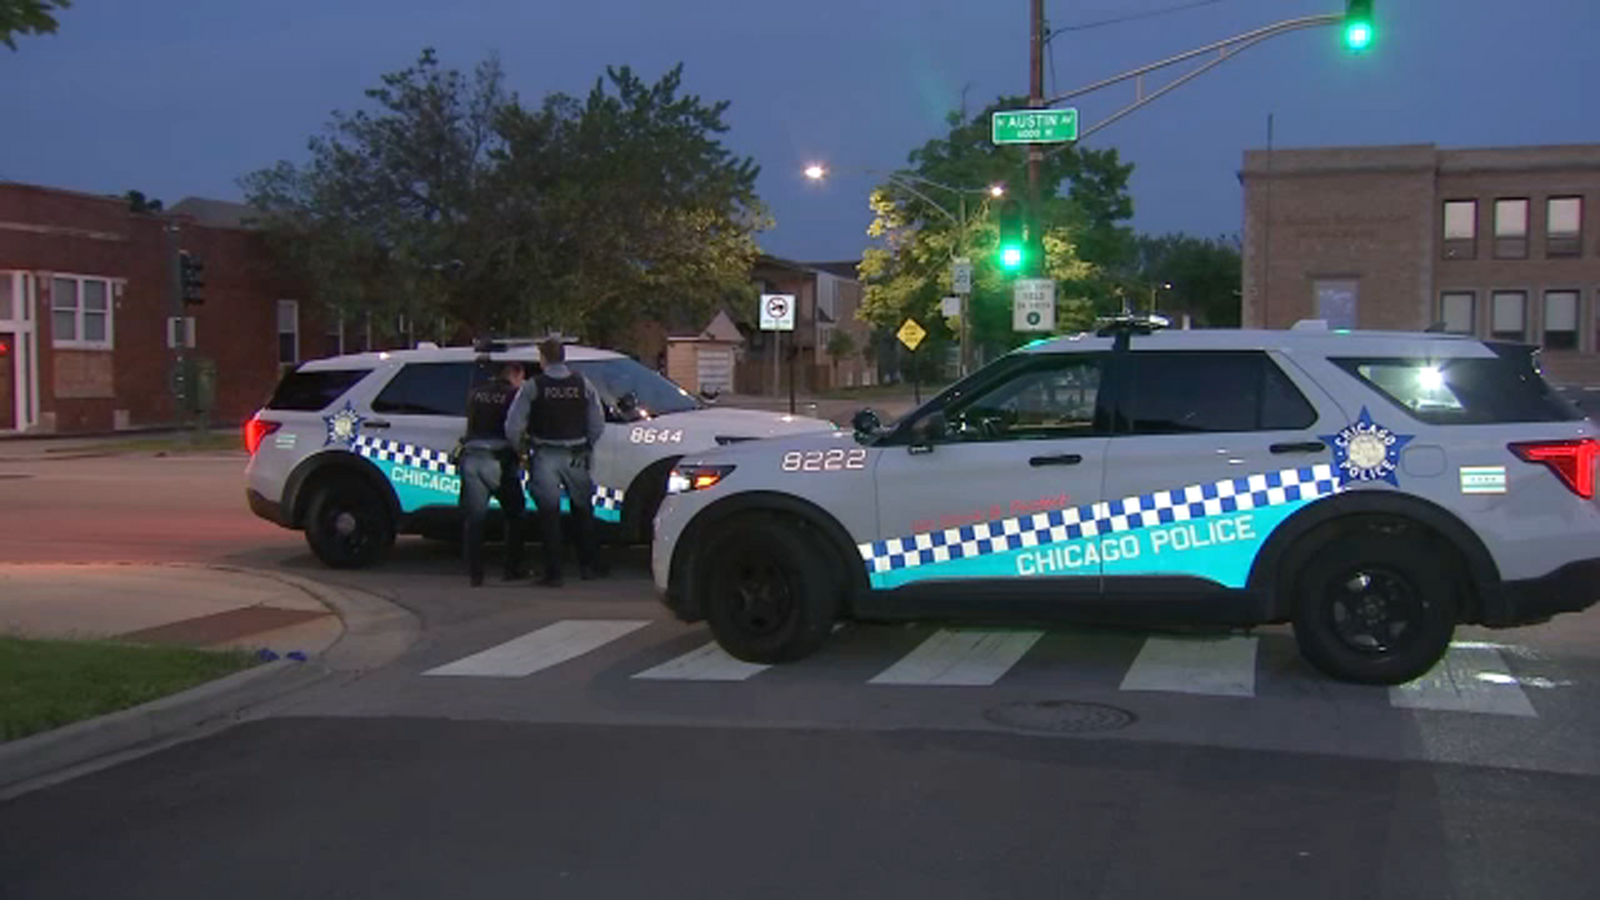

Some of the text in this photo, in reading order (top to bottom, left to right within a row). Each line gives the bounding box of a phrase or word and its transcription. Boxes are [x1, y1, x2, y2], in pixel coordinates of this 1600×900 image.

[1007, 114, 1058, 128] AUSTIN
[474, 391, 507, 404] POLICE
[544, 386, 579, 399] POLICE
[630, 427, 683, 443] 8644
[1334, 421, 1396, 447] CHICAGO
[782, 448, 867, 471] 8222
[1339, 459, 1396, 481] POLICE
[391, 466, 461, 495] CHICAGO
[1016, 515, 1256, 576] CHICAGO POLICE
